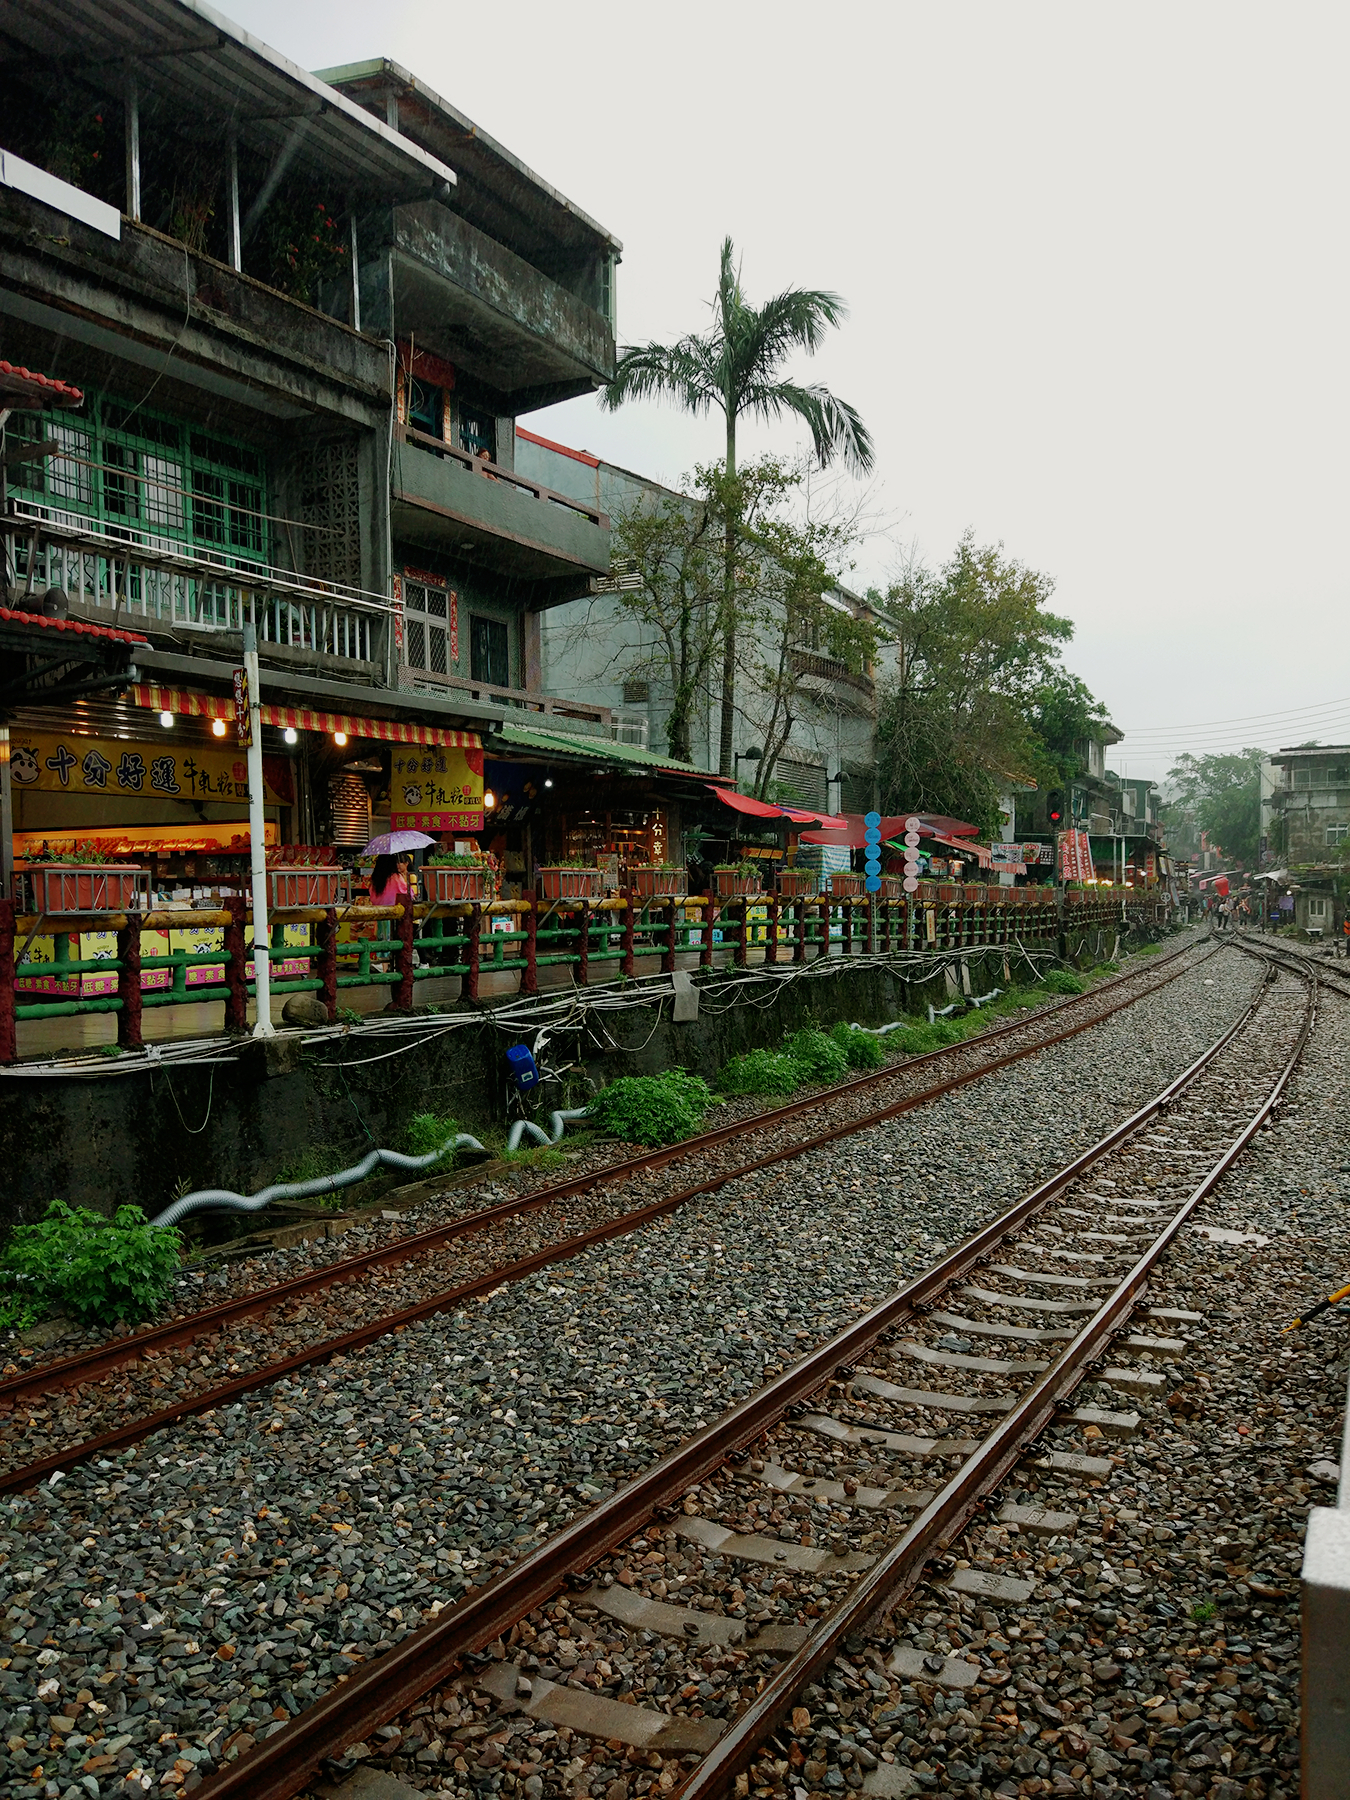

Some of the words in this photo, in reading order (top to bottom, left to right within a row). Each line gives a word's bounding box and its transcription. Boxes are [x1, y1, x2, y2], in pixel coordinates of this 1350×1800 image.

[46, 744, 181, 794] 十分好運
[394, 756, 448, 774] 十分好運
